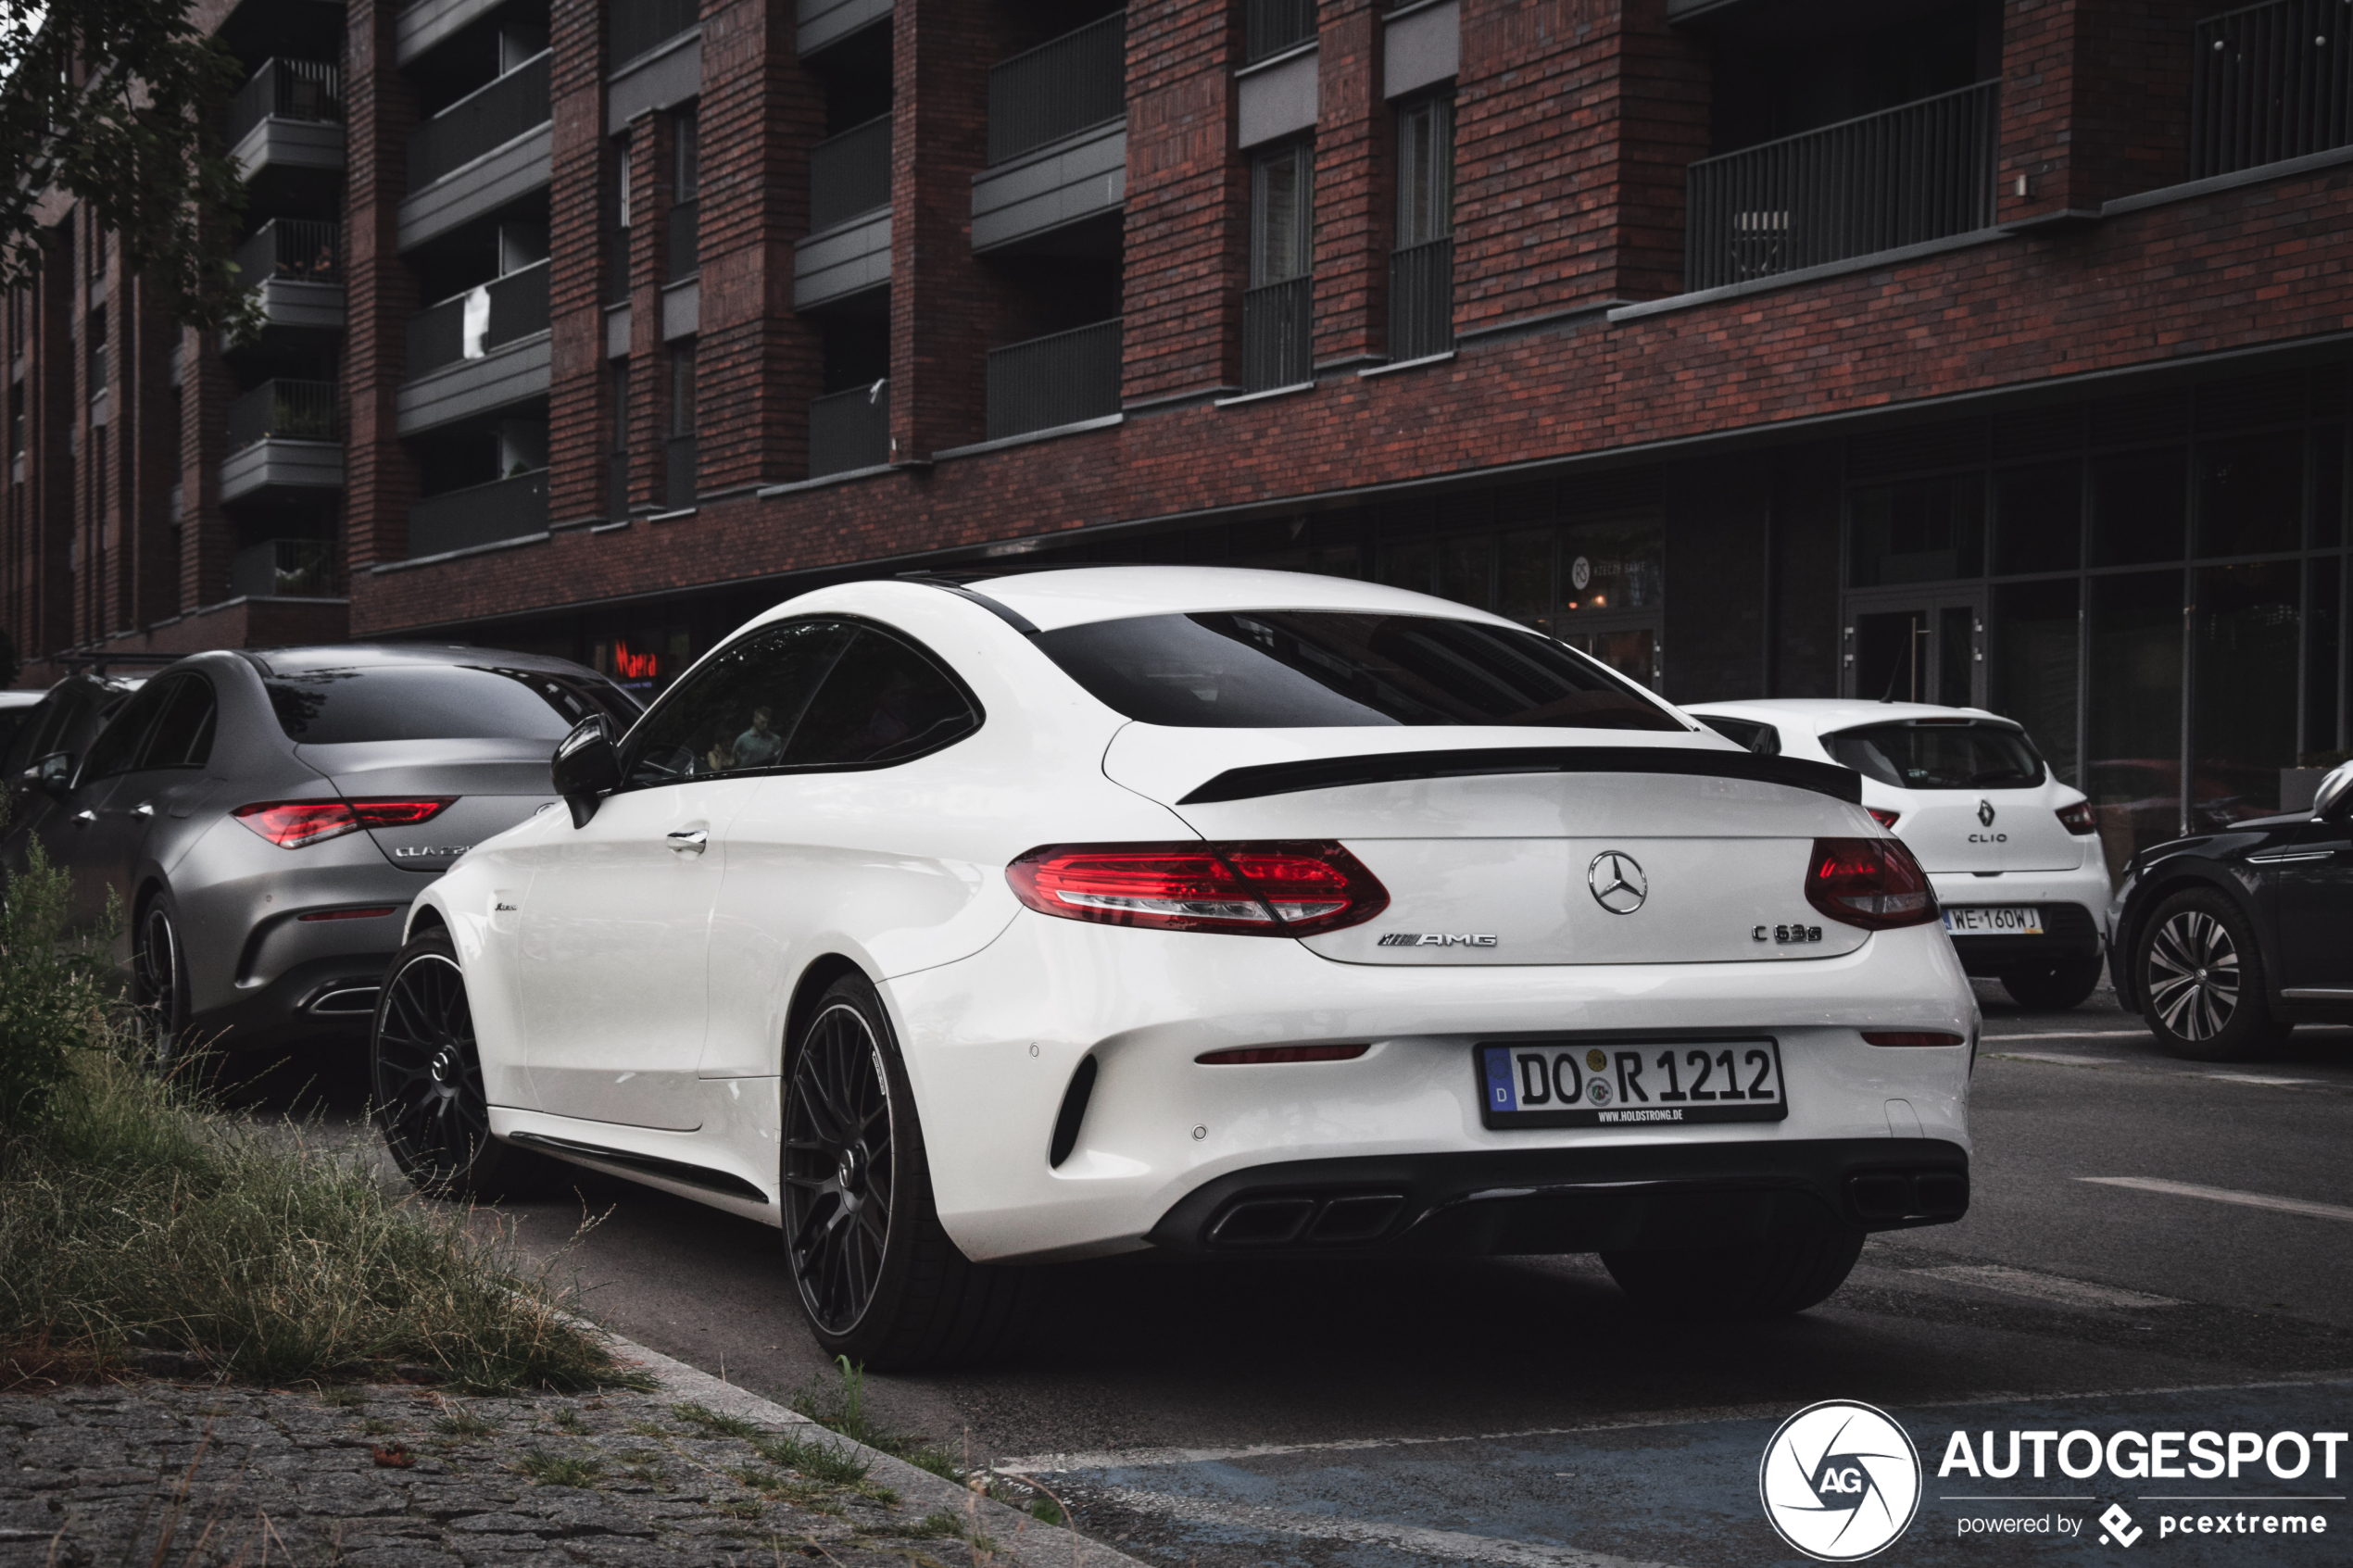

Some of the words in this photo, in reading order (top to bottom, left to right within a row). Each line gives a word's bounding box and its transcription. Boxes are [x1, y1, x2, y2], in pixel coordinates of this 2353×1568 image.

[1968, 834, 2007, 843] CLIO
[396, 847, 435, 857] CLA
[1953, 909, 1979, 929] WE
[1415, 934, 1497, 947] AMG
[1752, 925, 1768, 942] C
[1516, 1052, 1582, 1104] DO
[1496, 1087, 1507, 1102] D
[1598, 1110, 1683, 1123] WWW.HOLDSTRONG.DE
